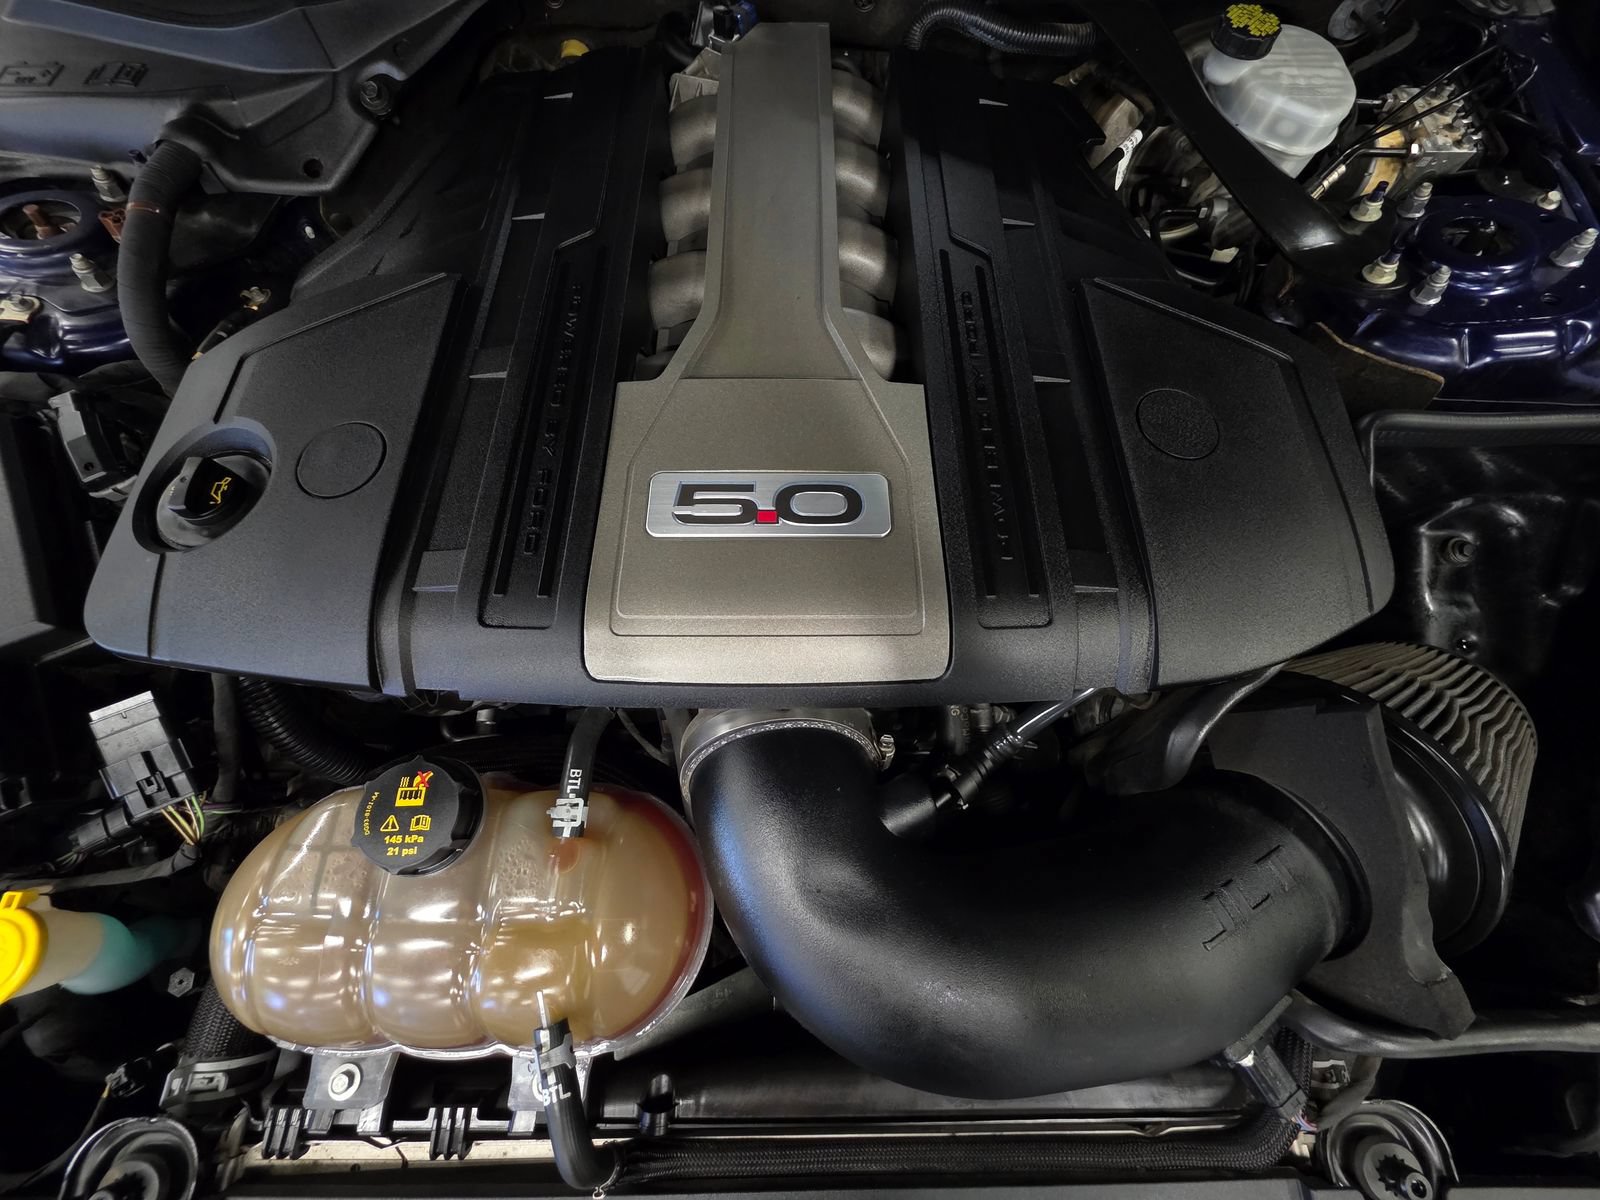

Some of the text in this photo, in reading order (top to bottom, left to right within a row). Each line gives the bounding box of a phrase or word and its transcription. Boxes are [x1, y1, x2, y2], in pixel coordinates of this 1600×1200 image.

[961, 291, 981, 356] FORD
[523, 468, 551, 555] FORD
[672, 481, 866, 526] 5.0
[566, 768, 582, 793] BTL
[384, 834, 424, 844] 145 kPa
[386, 846, 418, 857] 21 psi
[1201, 843, 1297, 952] JLT
[542, 1083, 572, 1107] BTL
